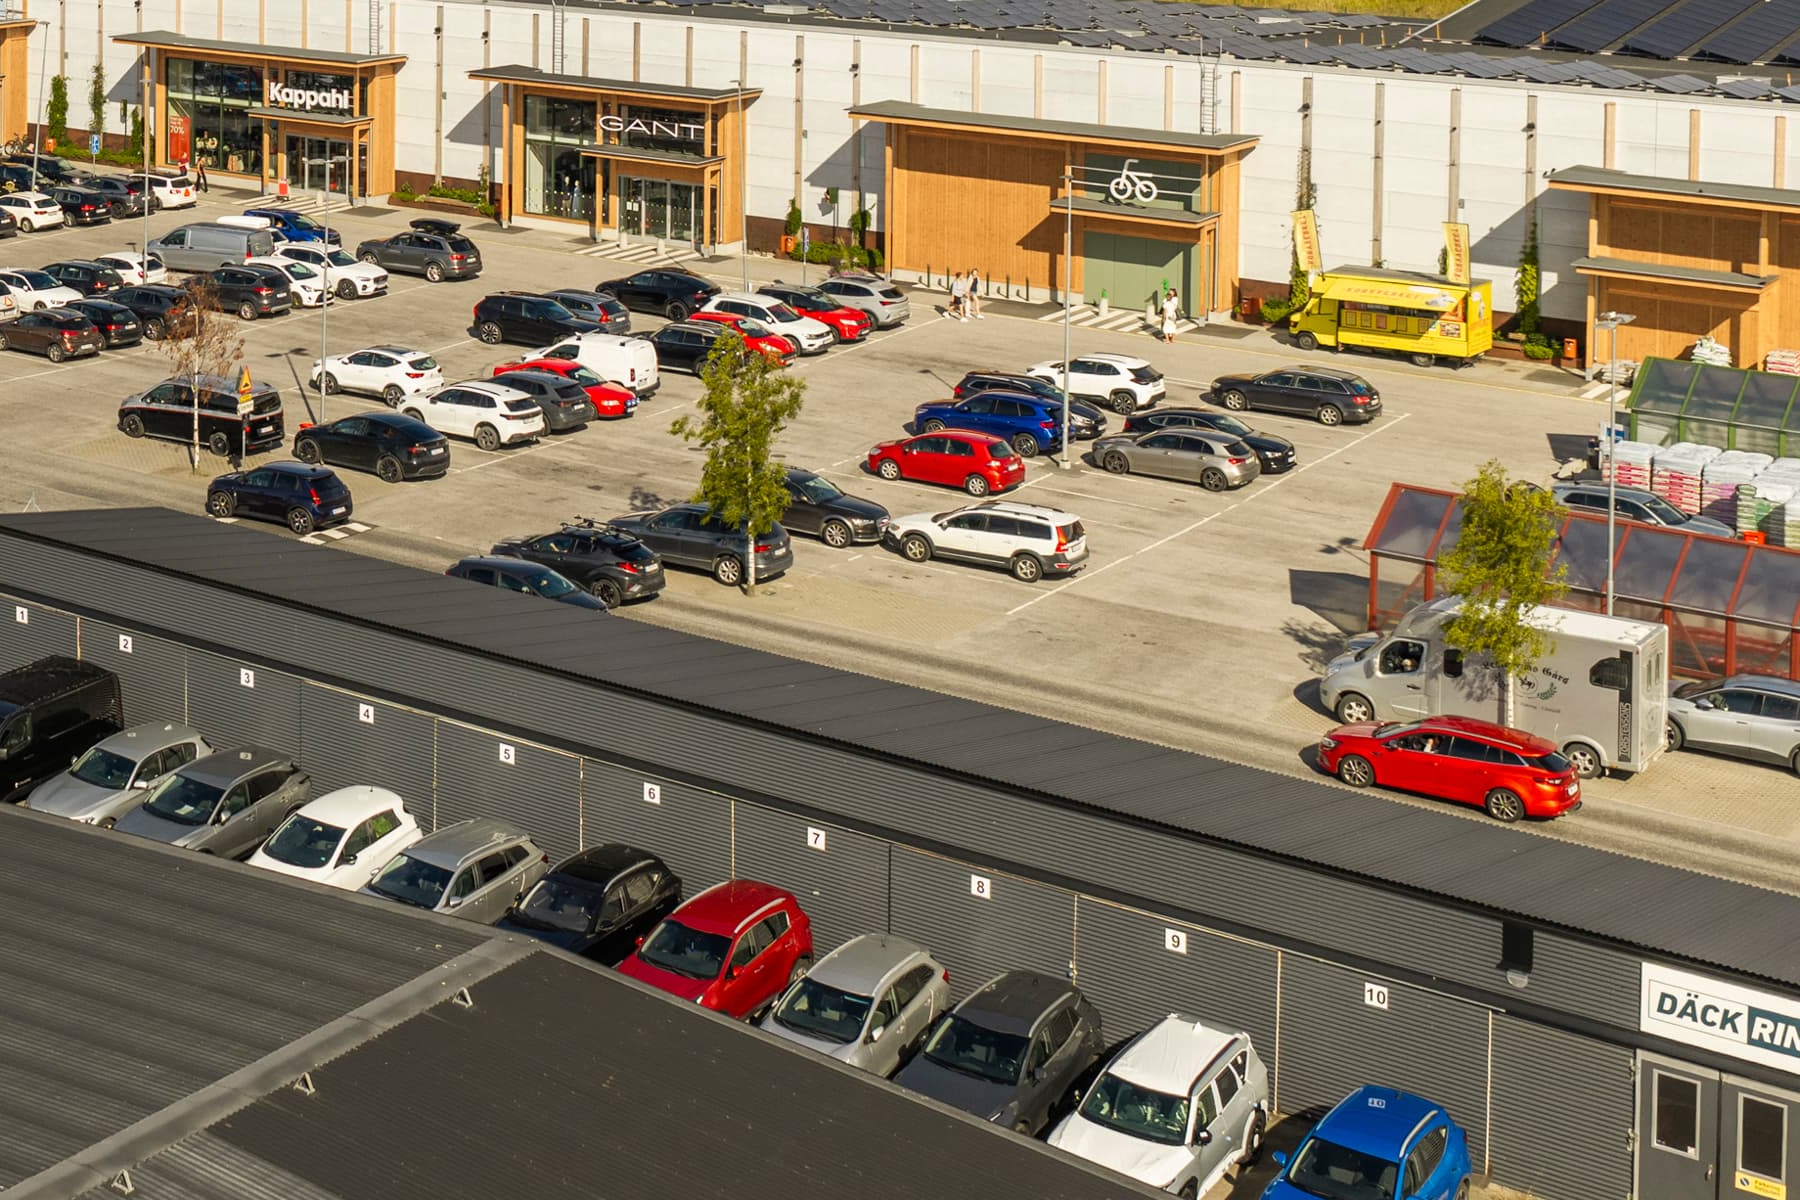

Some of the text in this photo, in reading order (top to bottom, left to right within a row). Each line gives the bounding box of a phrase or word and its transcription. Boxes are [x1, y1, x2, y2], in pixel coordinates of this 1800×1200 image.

[269, 82, 349, 109] Kappahl
[170, 126, 185, 134] 70%
[599, 115, 704, 139] GANT
[123, 638, 128, 649] 2
[244, 673, 250, 684] 3
[363, 708, 370, 719] 4
[504, 749, 511, 760] 5
[648, 787, 656, 799] 6
[813, 833, 820, 845] 7
[977, 881, 985, 893] 8
[1172, 935, 1180, 948] 9
[1366, 988, 1386, 1004] 10
[1656, 992, 1743, 1034] DÄCK
